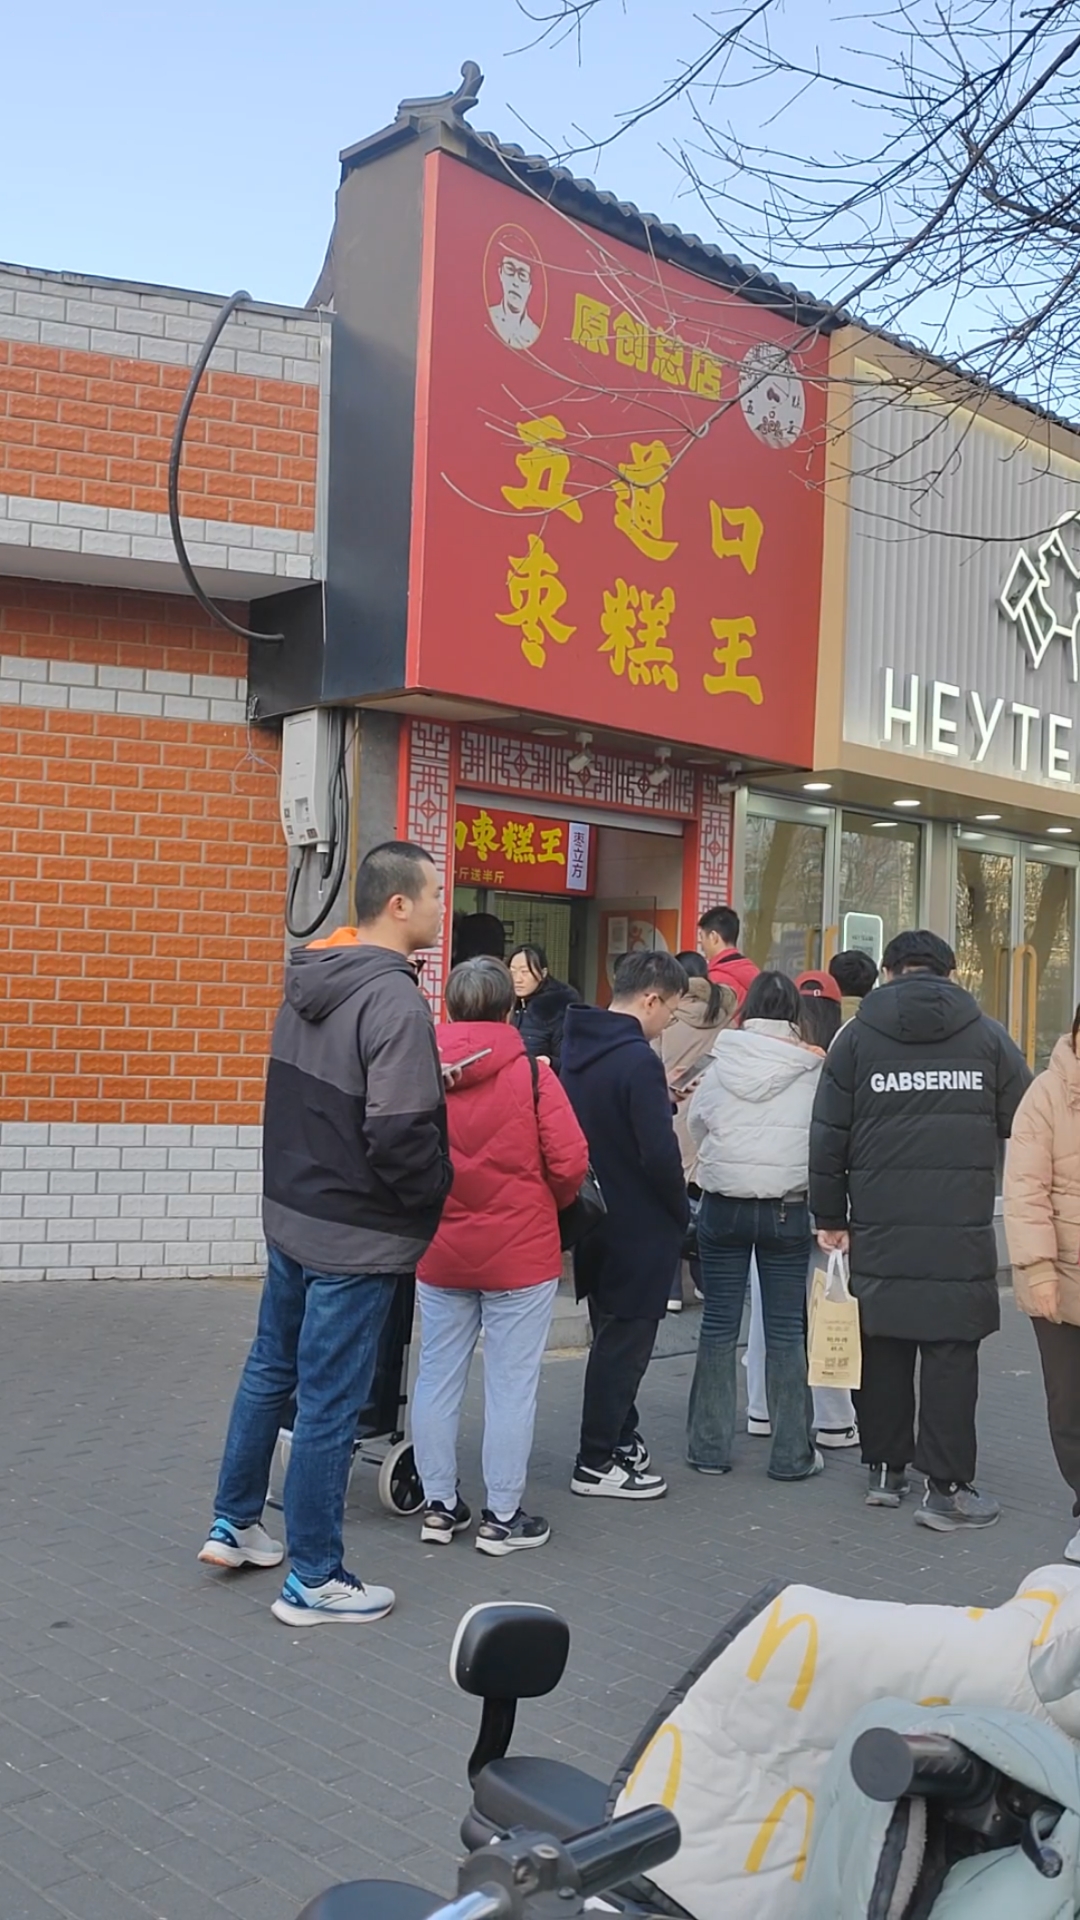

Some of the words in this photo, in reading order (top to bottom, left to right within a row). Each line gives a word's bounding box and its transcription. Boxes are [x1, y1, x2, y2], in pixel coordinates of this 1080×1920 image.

[571, 293, 722, 401] 原创总店
[501, 415, 763, 574] 五道口
[495, 534, 763, 705] 枣糕王
[454, 867, 505, 884] 斤送半斤
[571, 831, 586, 879] 枣立方
[870, 1071, 983, 1092] GABSERINE
